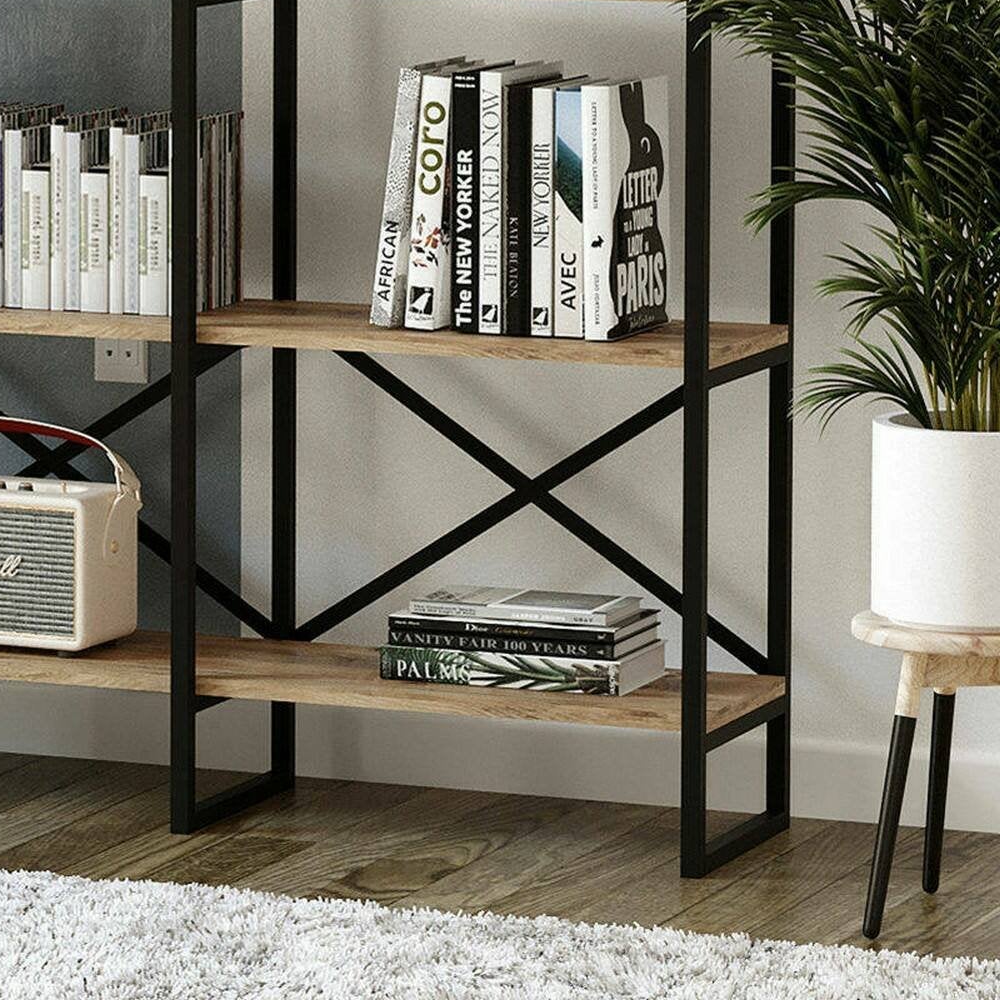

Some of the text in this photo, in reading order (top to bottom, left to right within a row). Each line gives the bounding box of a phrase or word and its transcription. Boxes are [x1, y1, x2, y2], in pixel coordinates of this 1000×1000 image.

[417, 101, 446, 196] coro
[481, 89, 500, 280] THE NAKED NOW
[622, 166, 658, 210] LETTER
[532, 143, 550, 248] NEW YORKER
[377, 220, 400, 302] AFRICAN
[456, 150, 473, 327] The NEW YORKER
[508, 216, 519, 298] KATE BEATON
[560, 252, 577, 310] AVEC
[616, 251, 665, 318] PARIS
[390, 630, 588, 656] VANITY FAIR 100 YEARS
[396, 659, 472, 684] PALMS
